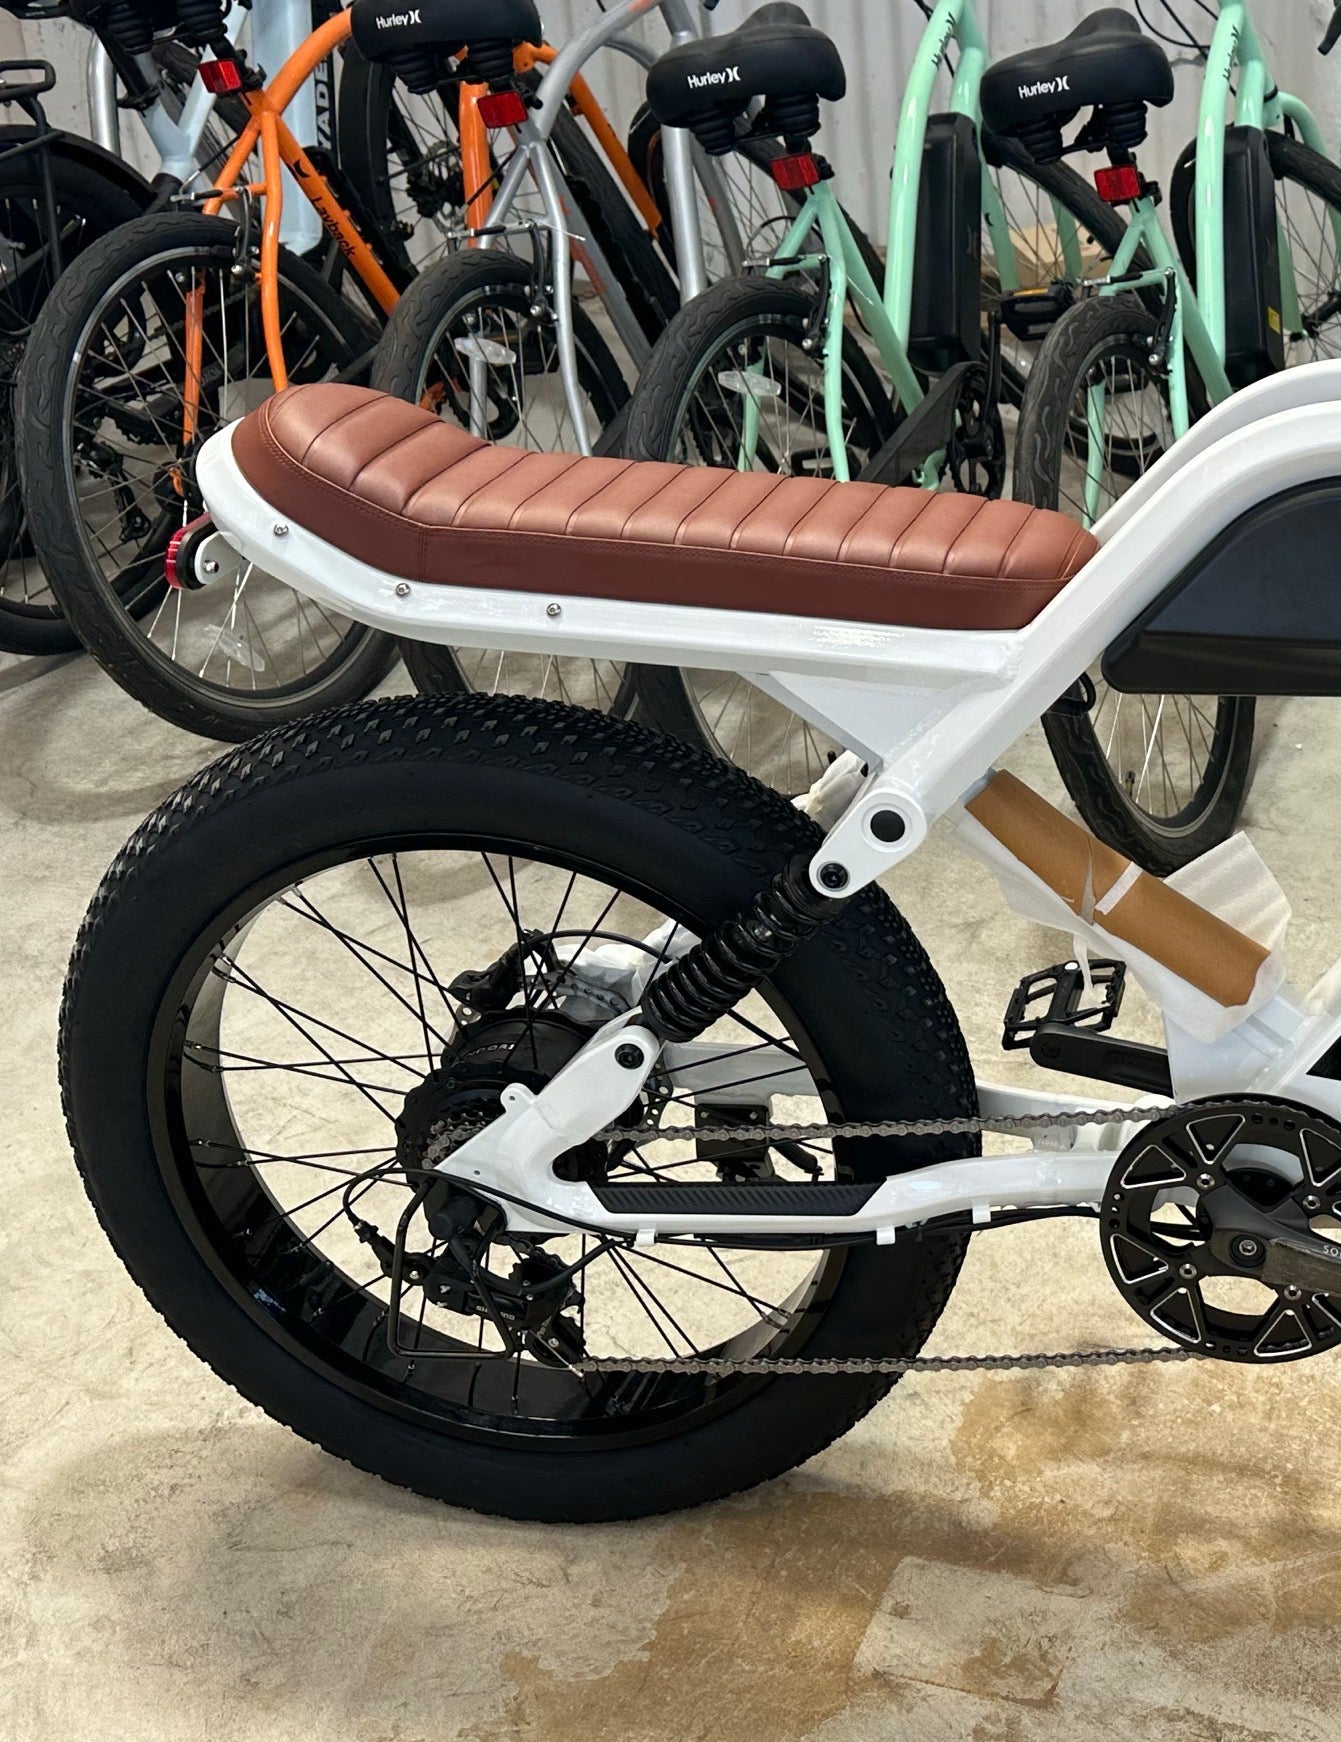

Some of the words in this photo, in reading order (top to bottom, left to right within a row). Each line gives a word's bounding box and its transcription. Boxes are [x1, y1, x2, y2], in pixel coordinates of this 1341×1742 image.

[375, 14, 409, 30] Hurley
[687, 71, 726, 89] Hurley
[1018, 80, 1056, 99] Hurley
[313, 57, 331, 150] YADE
[310, 196, 356, 256] Layback
